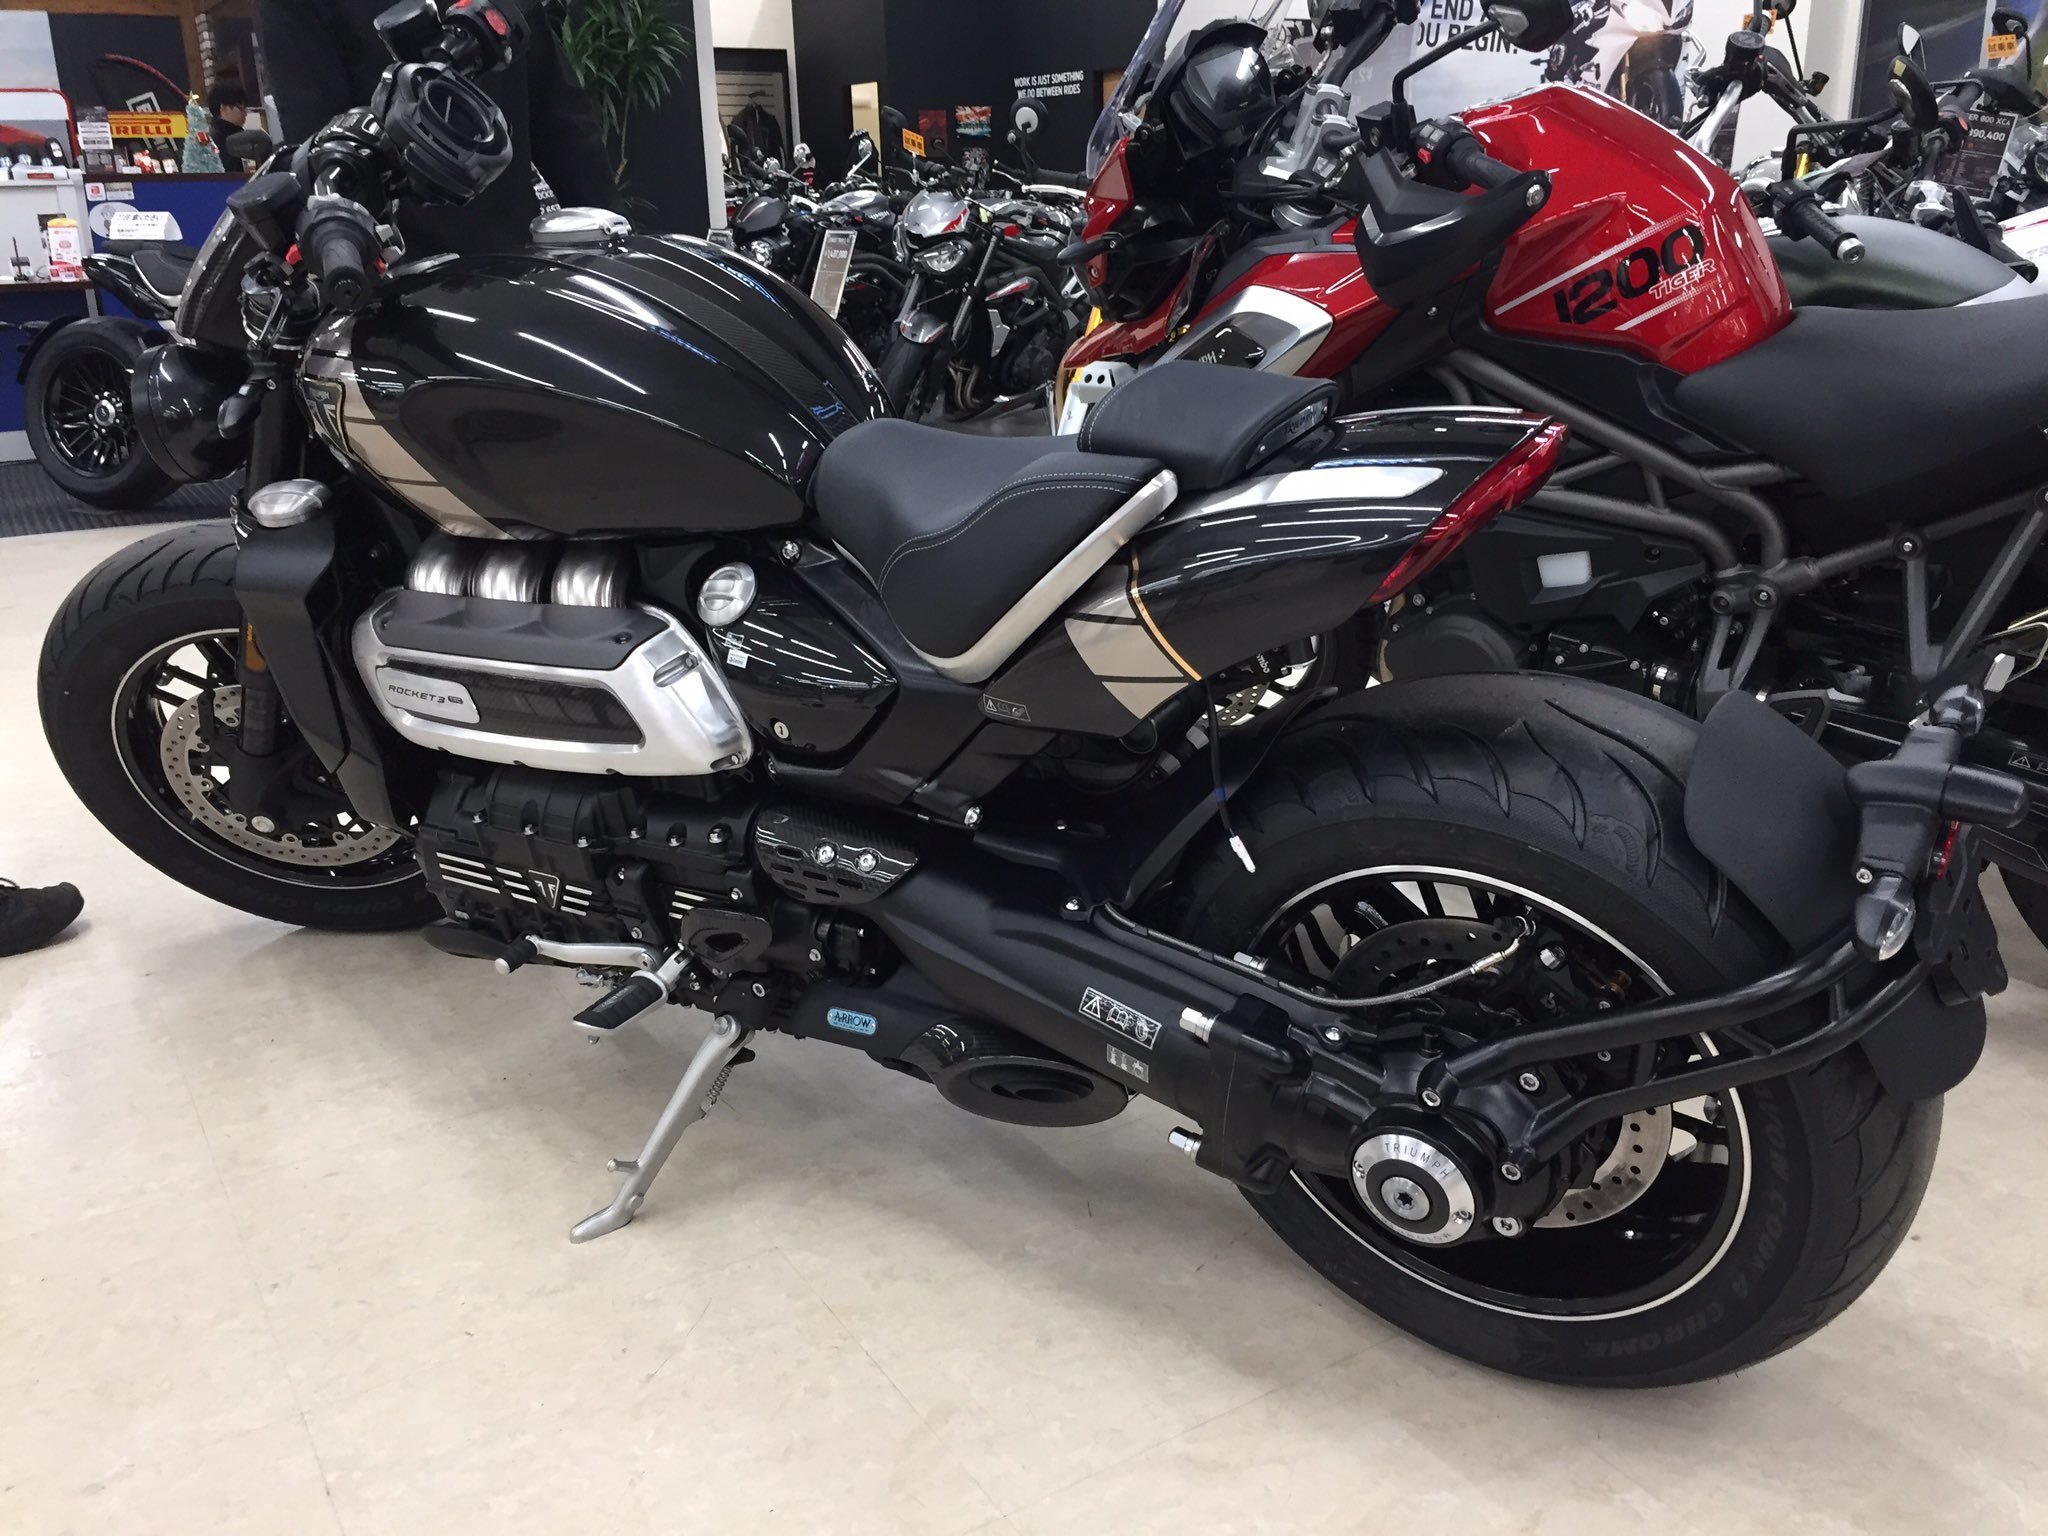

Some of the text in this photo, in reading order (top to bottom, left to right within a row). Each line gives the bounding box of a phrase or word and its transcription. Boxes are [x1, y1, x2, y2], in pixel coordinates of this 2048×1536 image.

[1431, 0, 1474, 21] END
[1014, 70, 1084, 88] WORK IS JUST SOMETHING
[1017, 83, 1081, 99] WE DO BETWEEN RIDES
[1553, 224, 1705, 325] 1200
[1648, 257, 1717, 300] TIGER
[833, 1011, 872, 1028] ARROW
[1384, 1142, 1451, 1178] TRIUMPH
